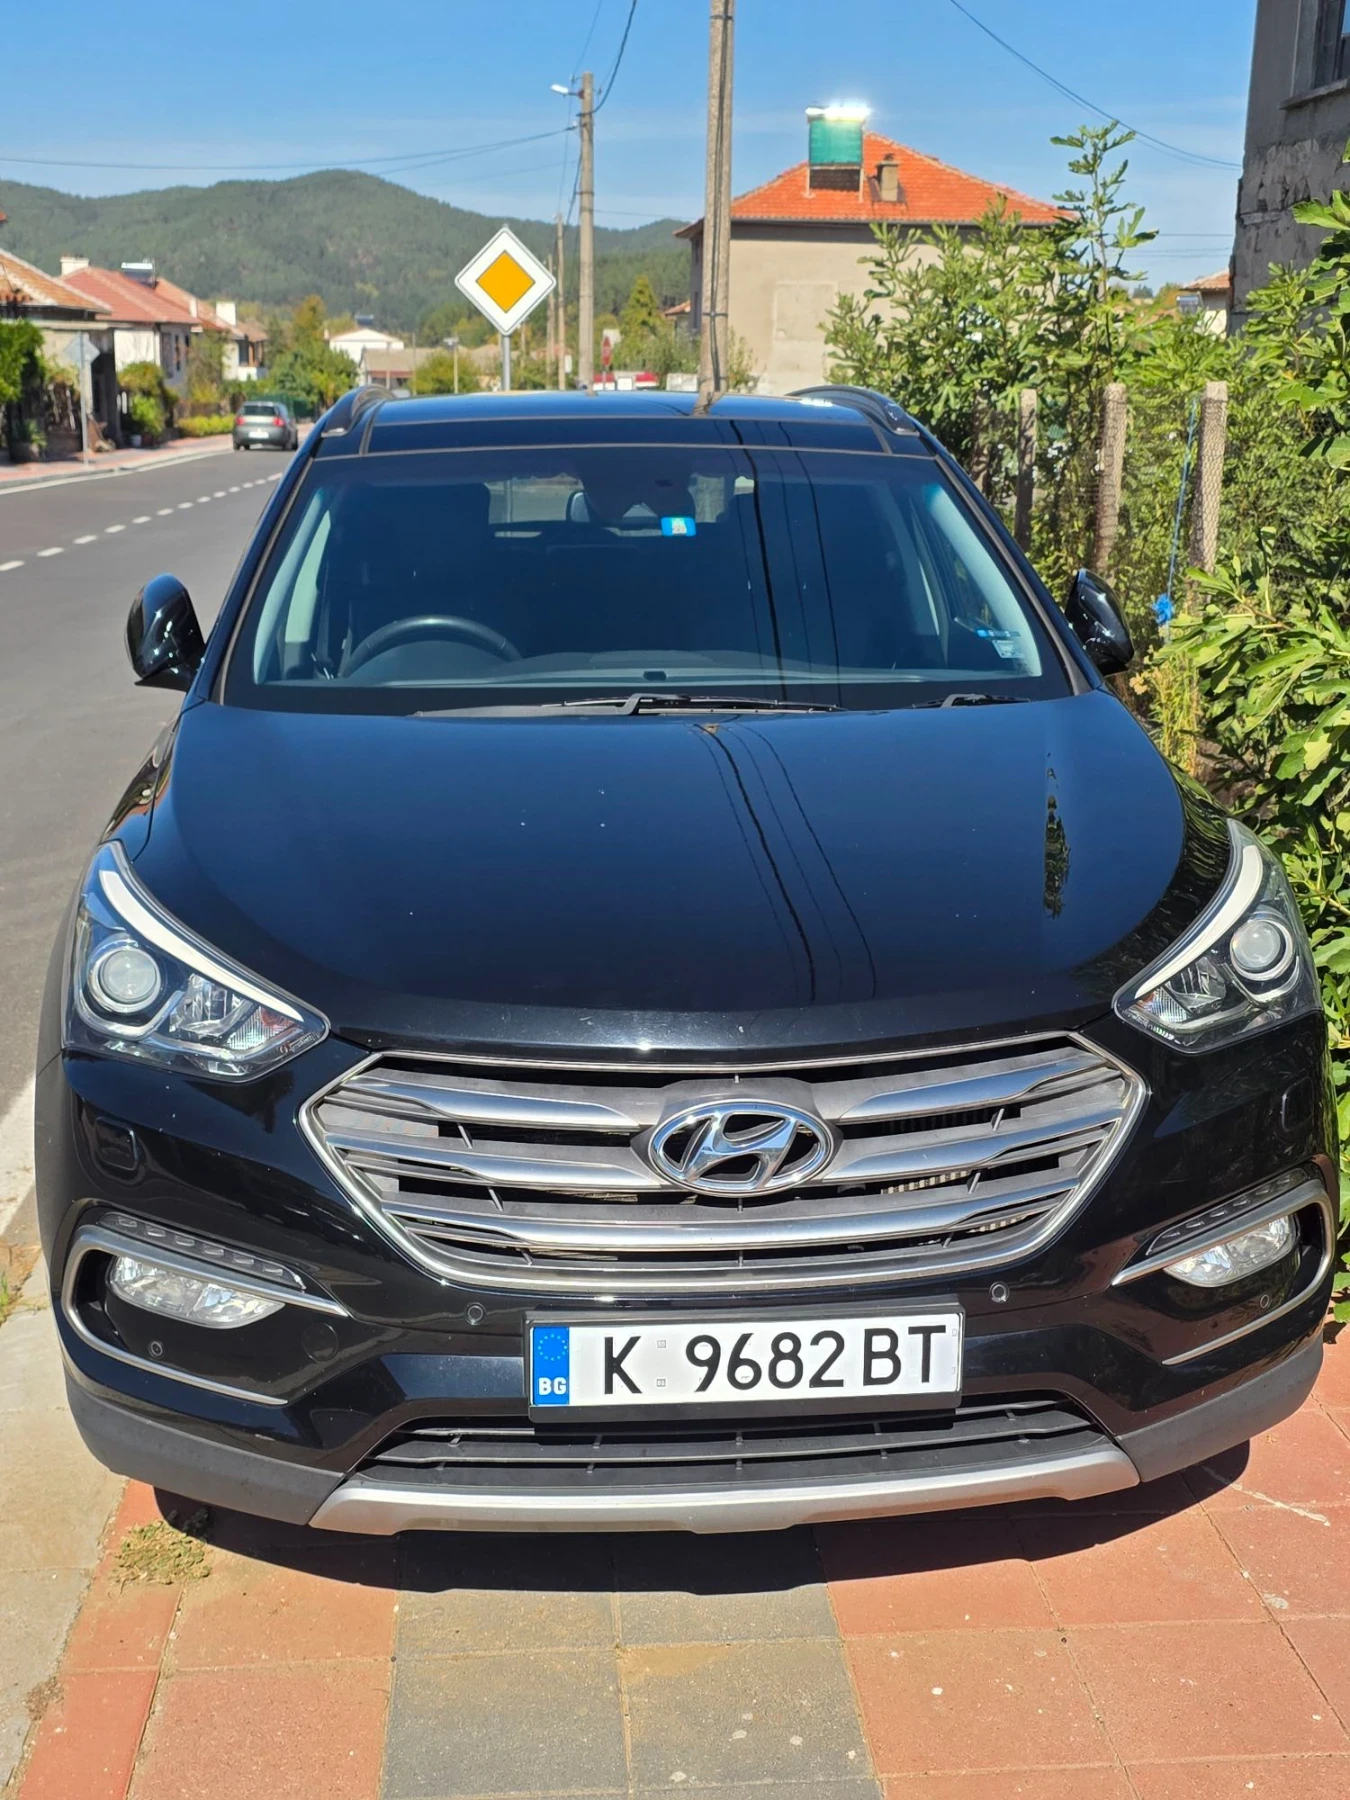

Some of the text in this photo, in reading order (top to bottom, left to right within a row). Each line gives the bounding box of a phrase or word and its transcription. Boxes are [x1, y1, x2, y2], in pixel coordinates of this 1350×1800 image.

[604, 1325, 946, 1394] K 9682 BT
[538, 1377, 567, 1395] BG
